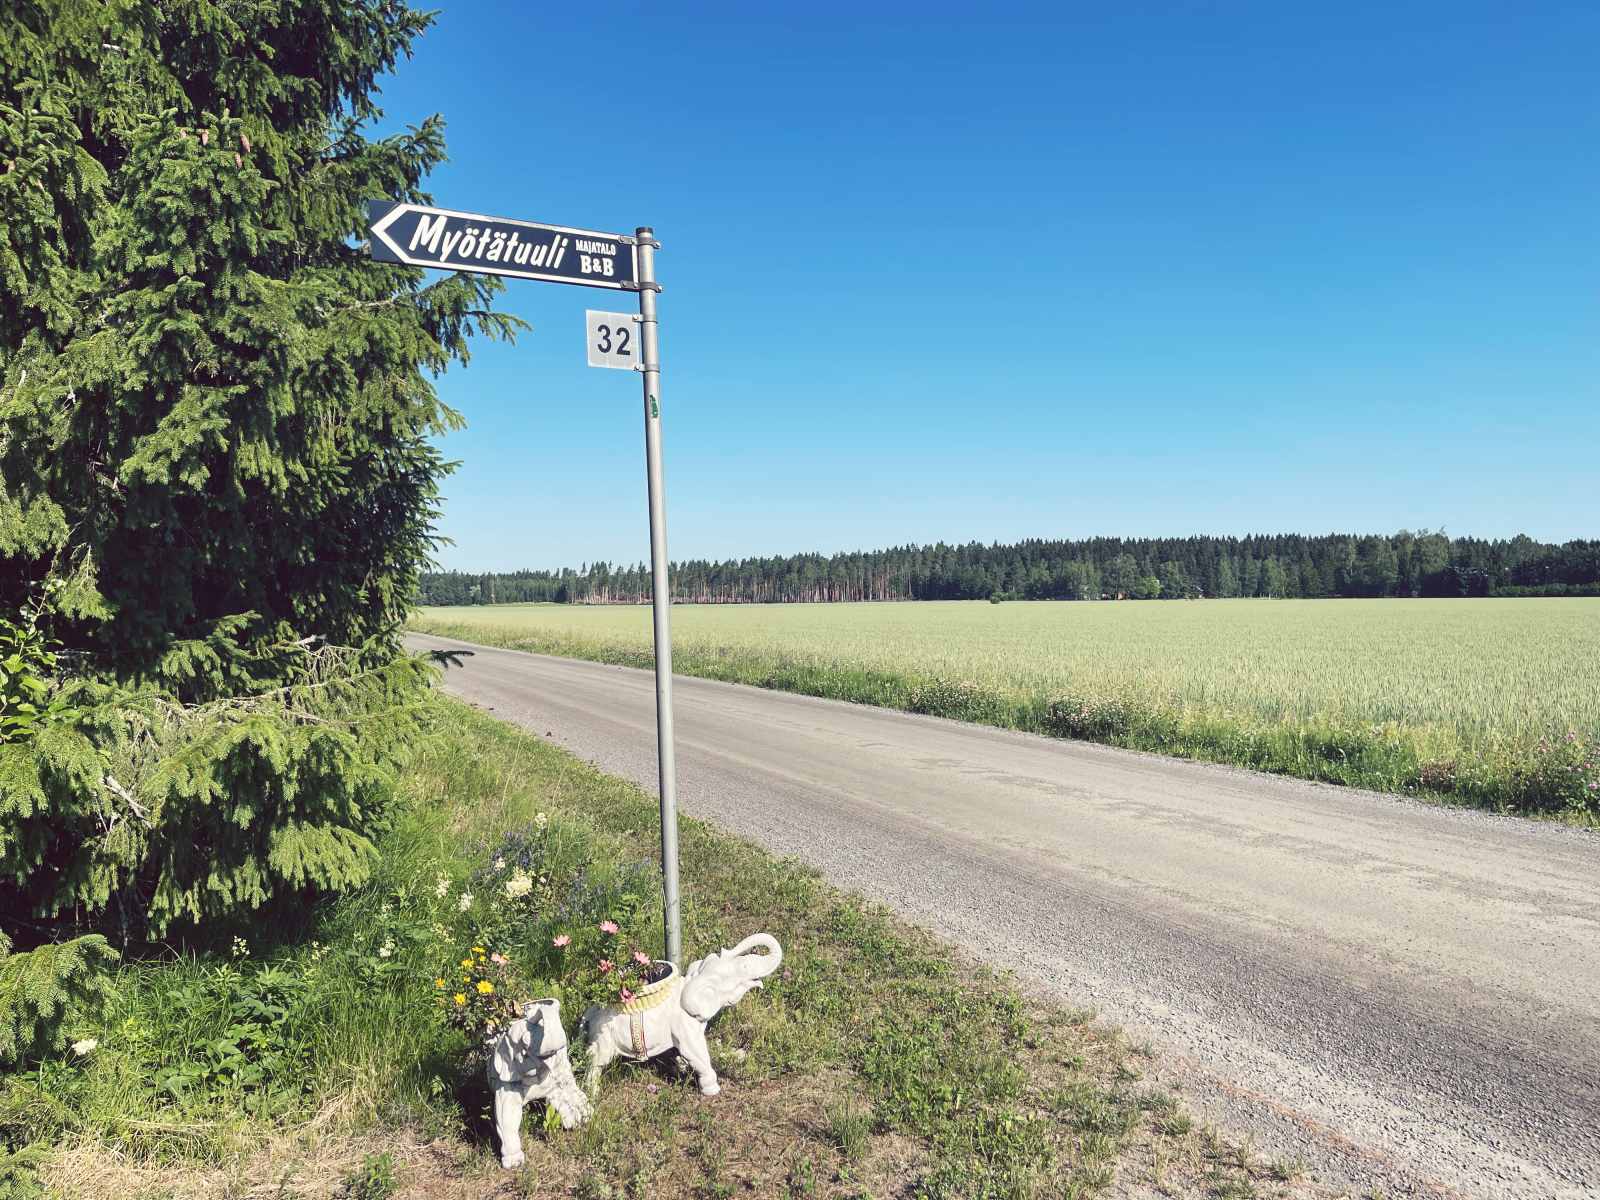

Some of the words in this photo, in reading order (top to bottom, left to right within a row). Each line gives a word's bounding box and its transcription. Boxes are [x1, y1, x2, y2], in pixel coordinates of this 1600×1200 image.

[408, 214, 568, 269] Myötätuuli
[575, 239, 616, 256] MAJATALO
[580, 255, 614, 277] B&B
[597, 324, 631, 356] 32
